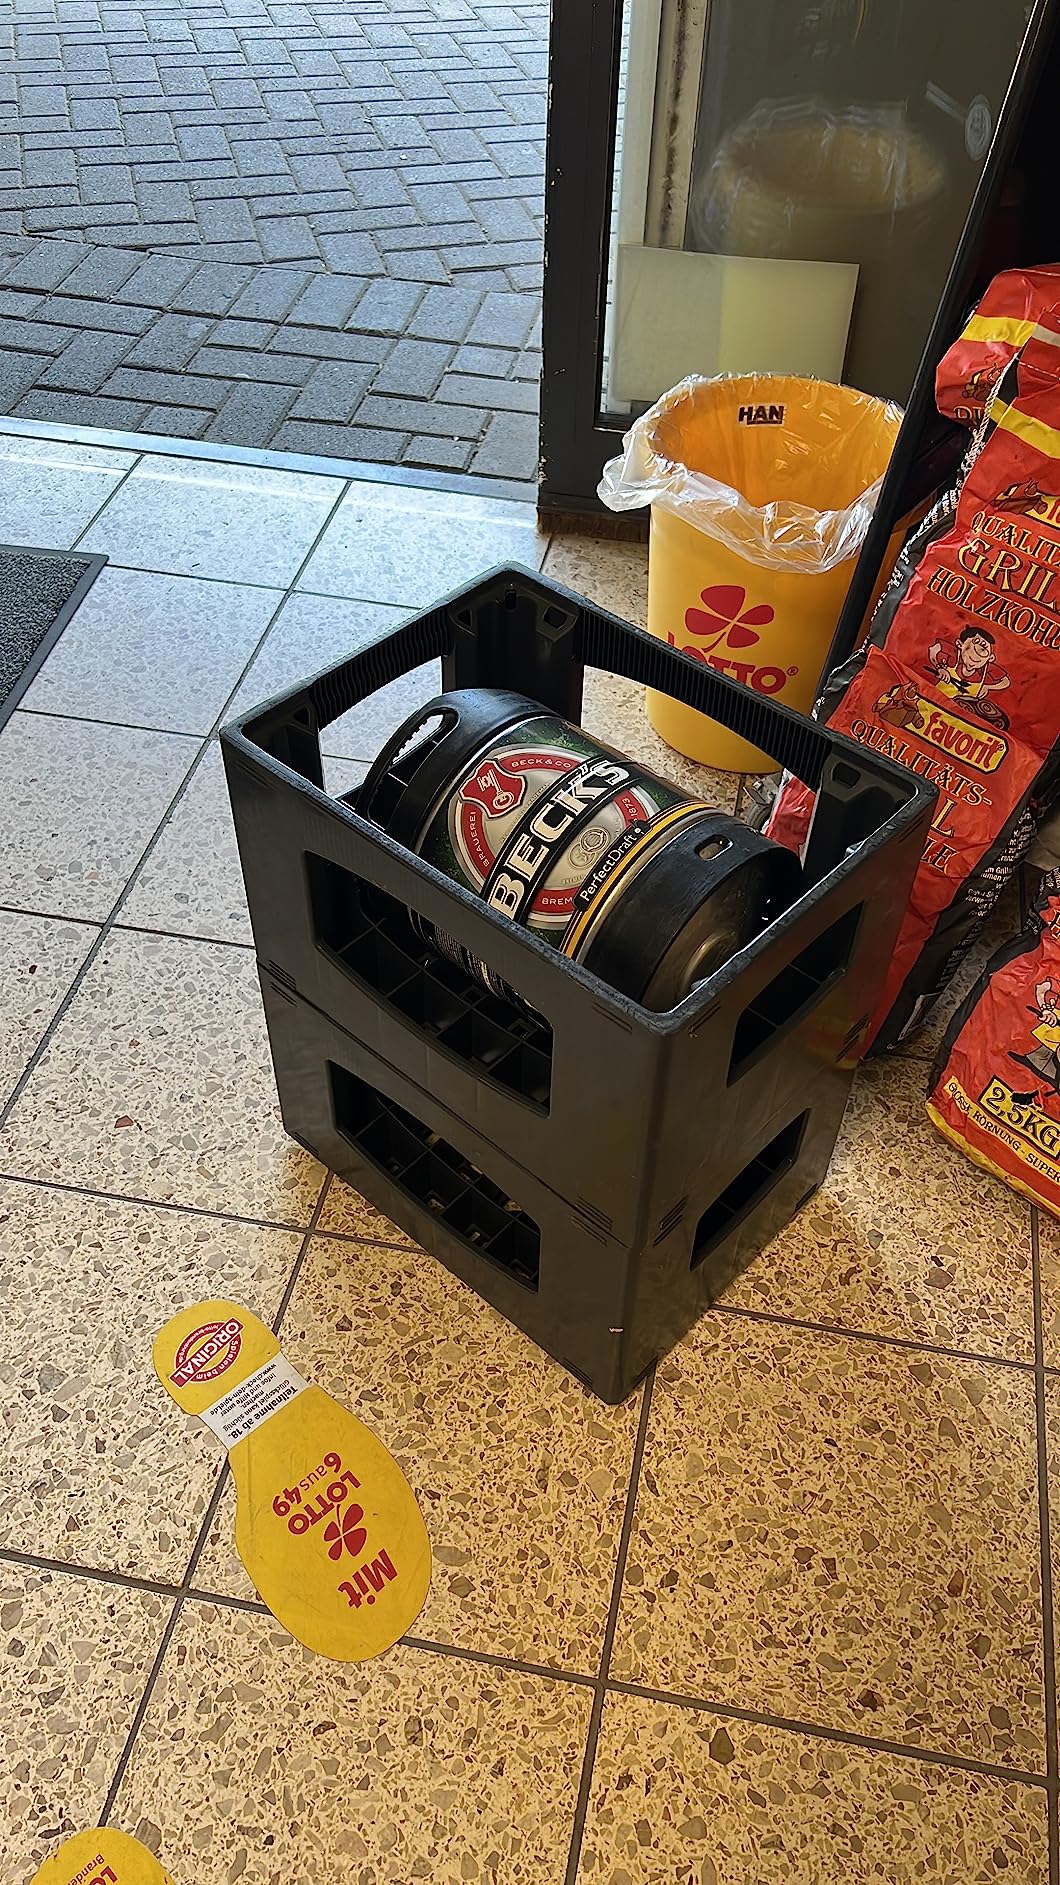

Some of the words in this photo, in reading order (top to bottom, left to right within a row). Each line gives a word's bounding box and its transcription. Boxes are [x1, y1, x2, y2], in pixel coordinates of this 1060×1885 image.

[739, 406, 784, 422] HAN
[972, 511, 1060, 568] QUALIT
[958, 537, 1060, 613] GRIL
[668, 631, 787, 695] TTO
[923, 712, 1001, 768] favorit
[470, 811, 490, 867] BRAUEREI
[579, 833, 638, 902] PerfectDraft
[173, 1321, 240, 1381] ORIGINAL
[241, 1417, 254, 1430] ab
[253, 1385, 299, 1421] Teilnahme
[287, 1469, 361, 1535] LOTTO
[337, 1548, 398, 1609] Mit
[67, 1853, 105, 1885] Brande
